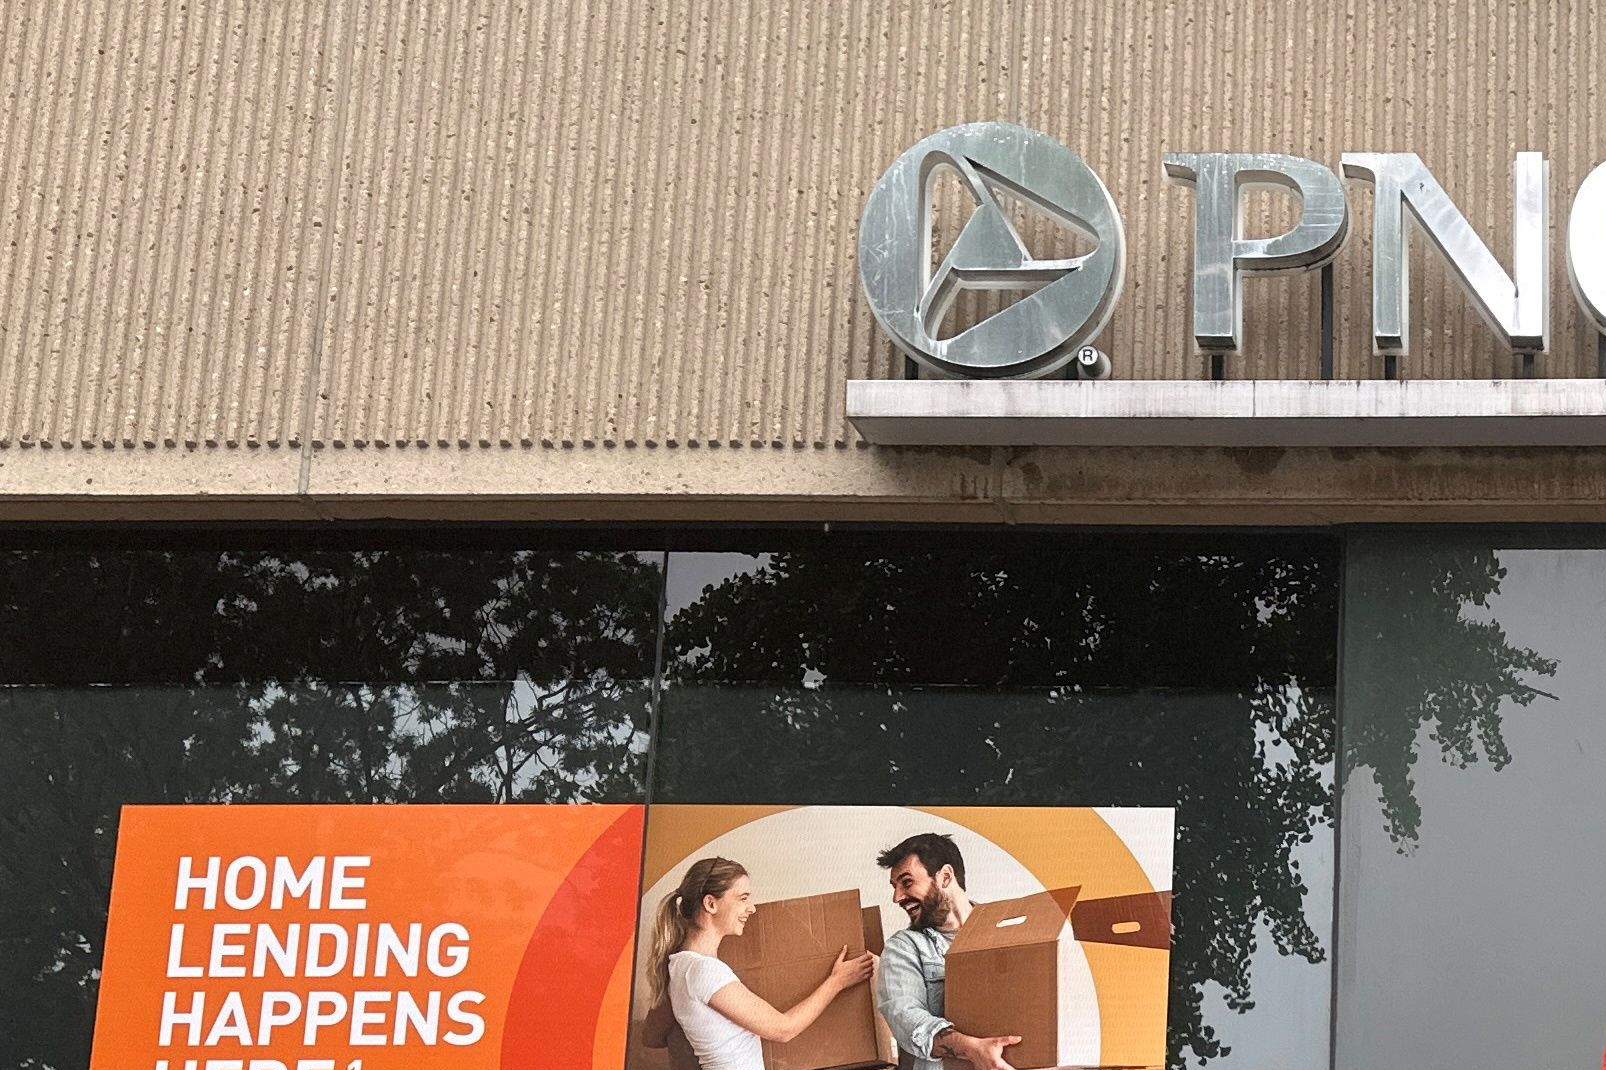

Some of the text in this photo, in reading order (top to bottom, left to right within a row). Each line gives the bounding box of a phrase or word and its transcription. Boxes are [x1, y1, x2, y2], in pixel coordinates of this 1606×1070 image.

[174, 855, 372, 911] HOME
[166, 922, 471, 978] LENDING
[158, 990, 486, 1046] HAPPENS
